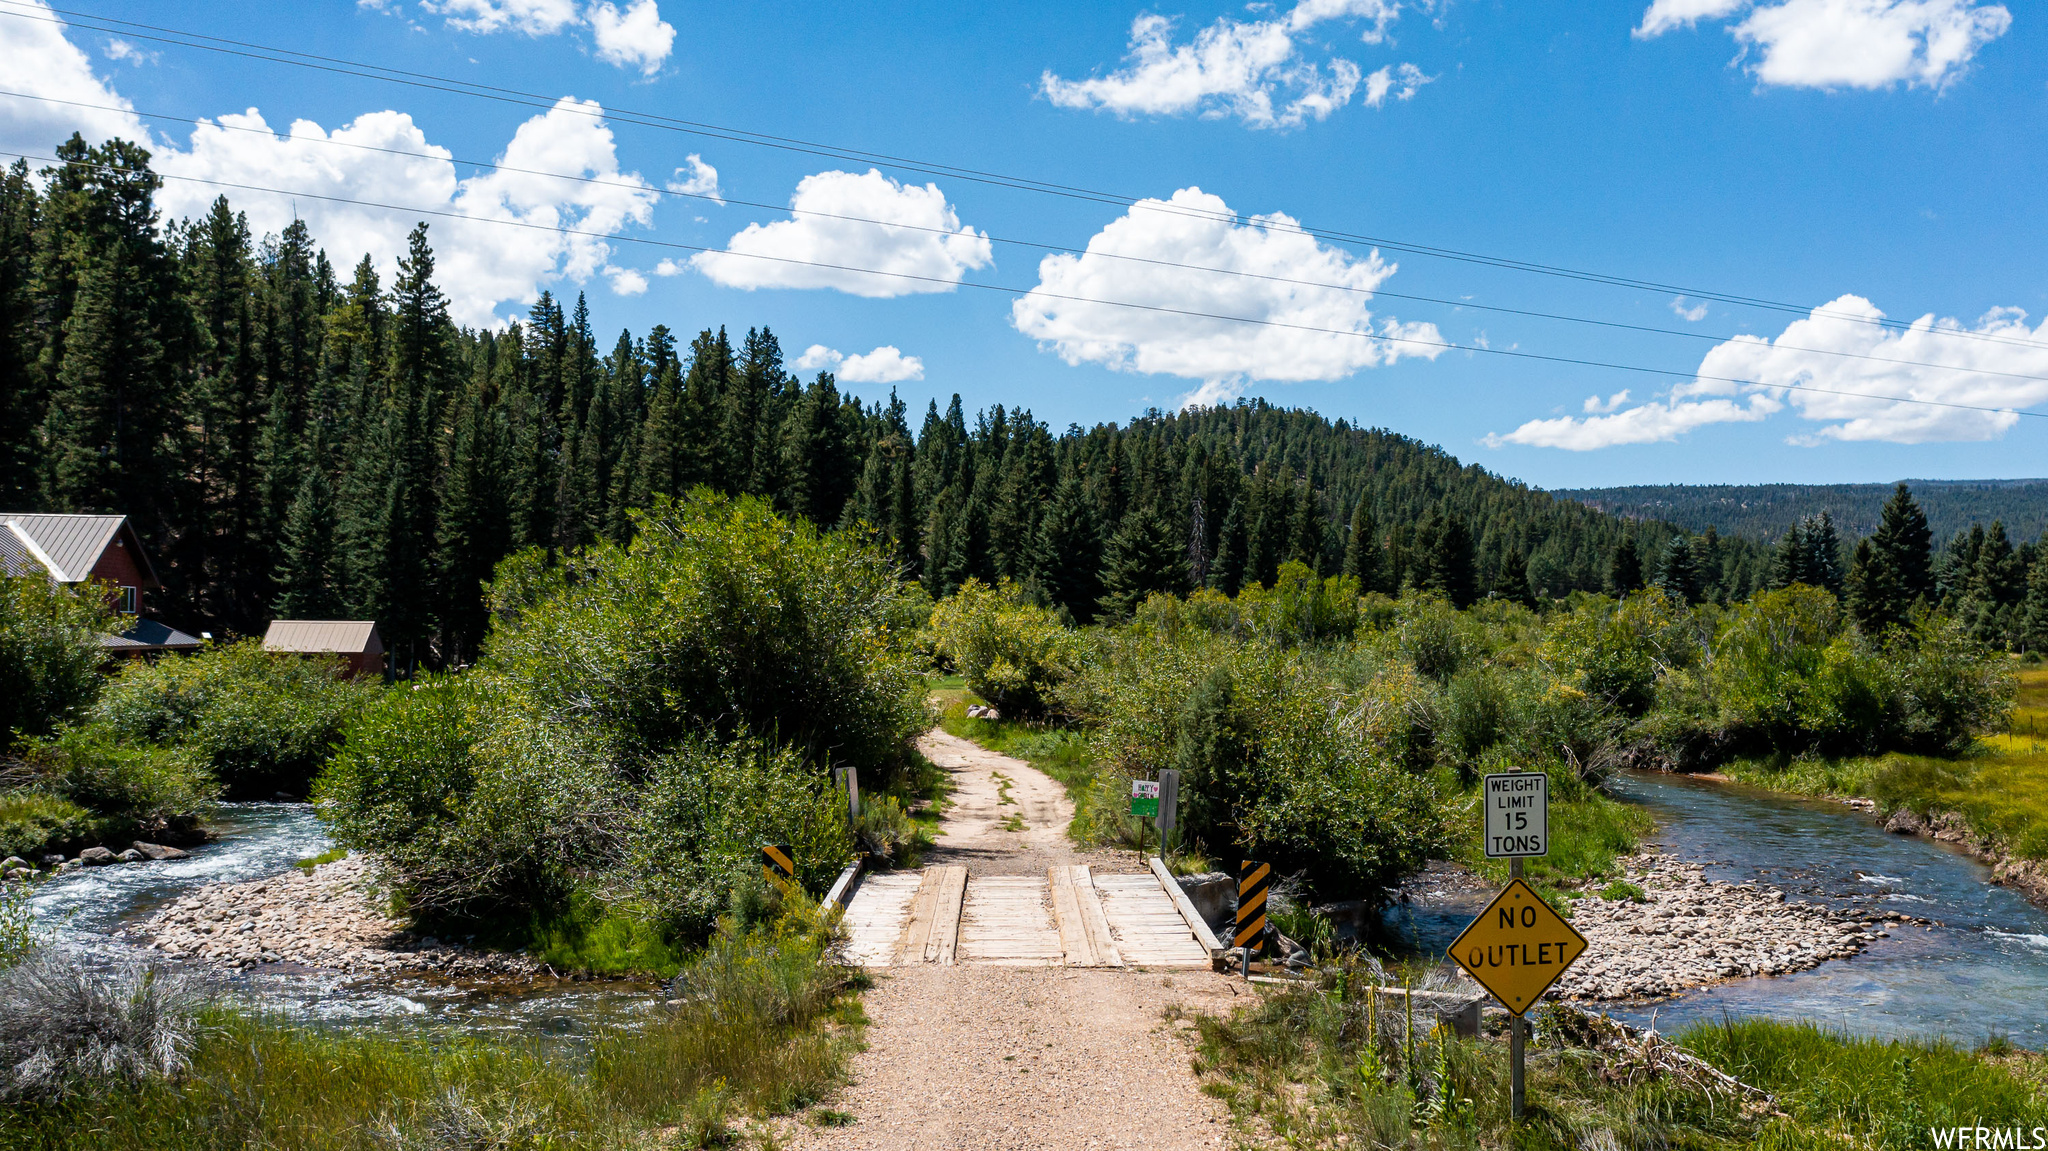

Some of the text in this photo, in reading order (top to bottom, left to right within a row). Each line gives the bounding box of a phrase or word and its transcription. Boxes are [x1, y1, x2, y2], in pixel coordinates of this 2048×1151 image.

[1491, 779, 1541, 792] WEIGHT
[1498, 796, 1534, 808] LIMIT
[1505, 812, 1527, 830] 15
[1492, 835, 1540, 852] TONS
[1499, 906, 1536, 929] NO
[1468, 942, 1568, 968] OUTLET
